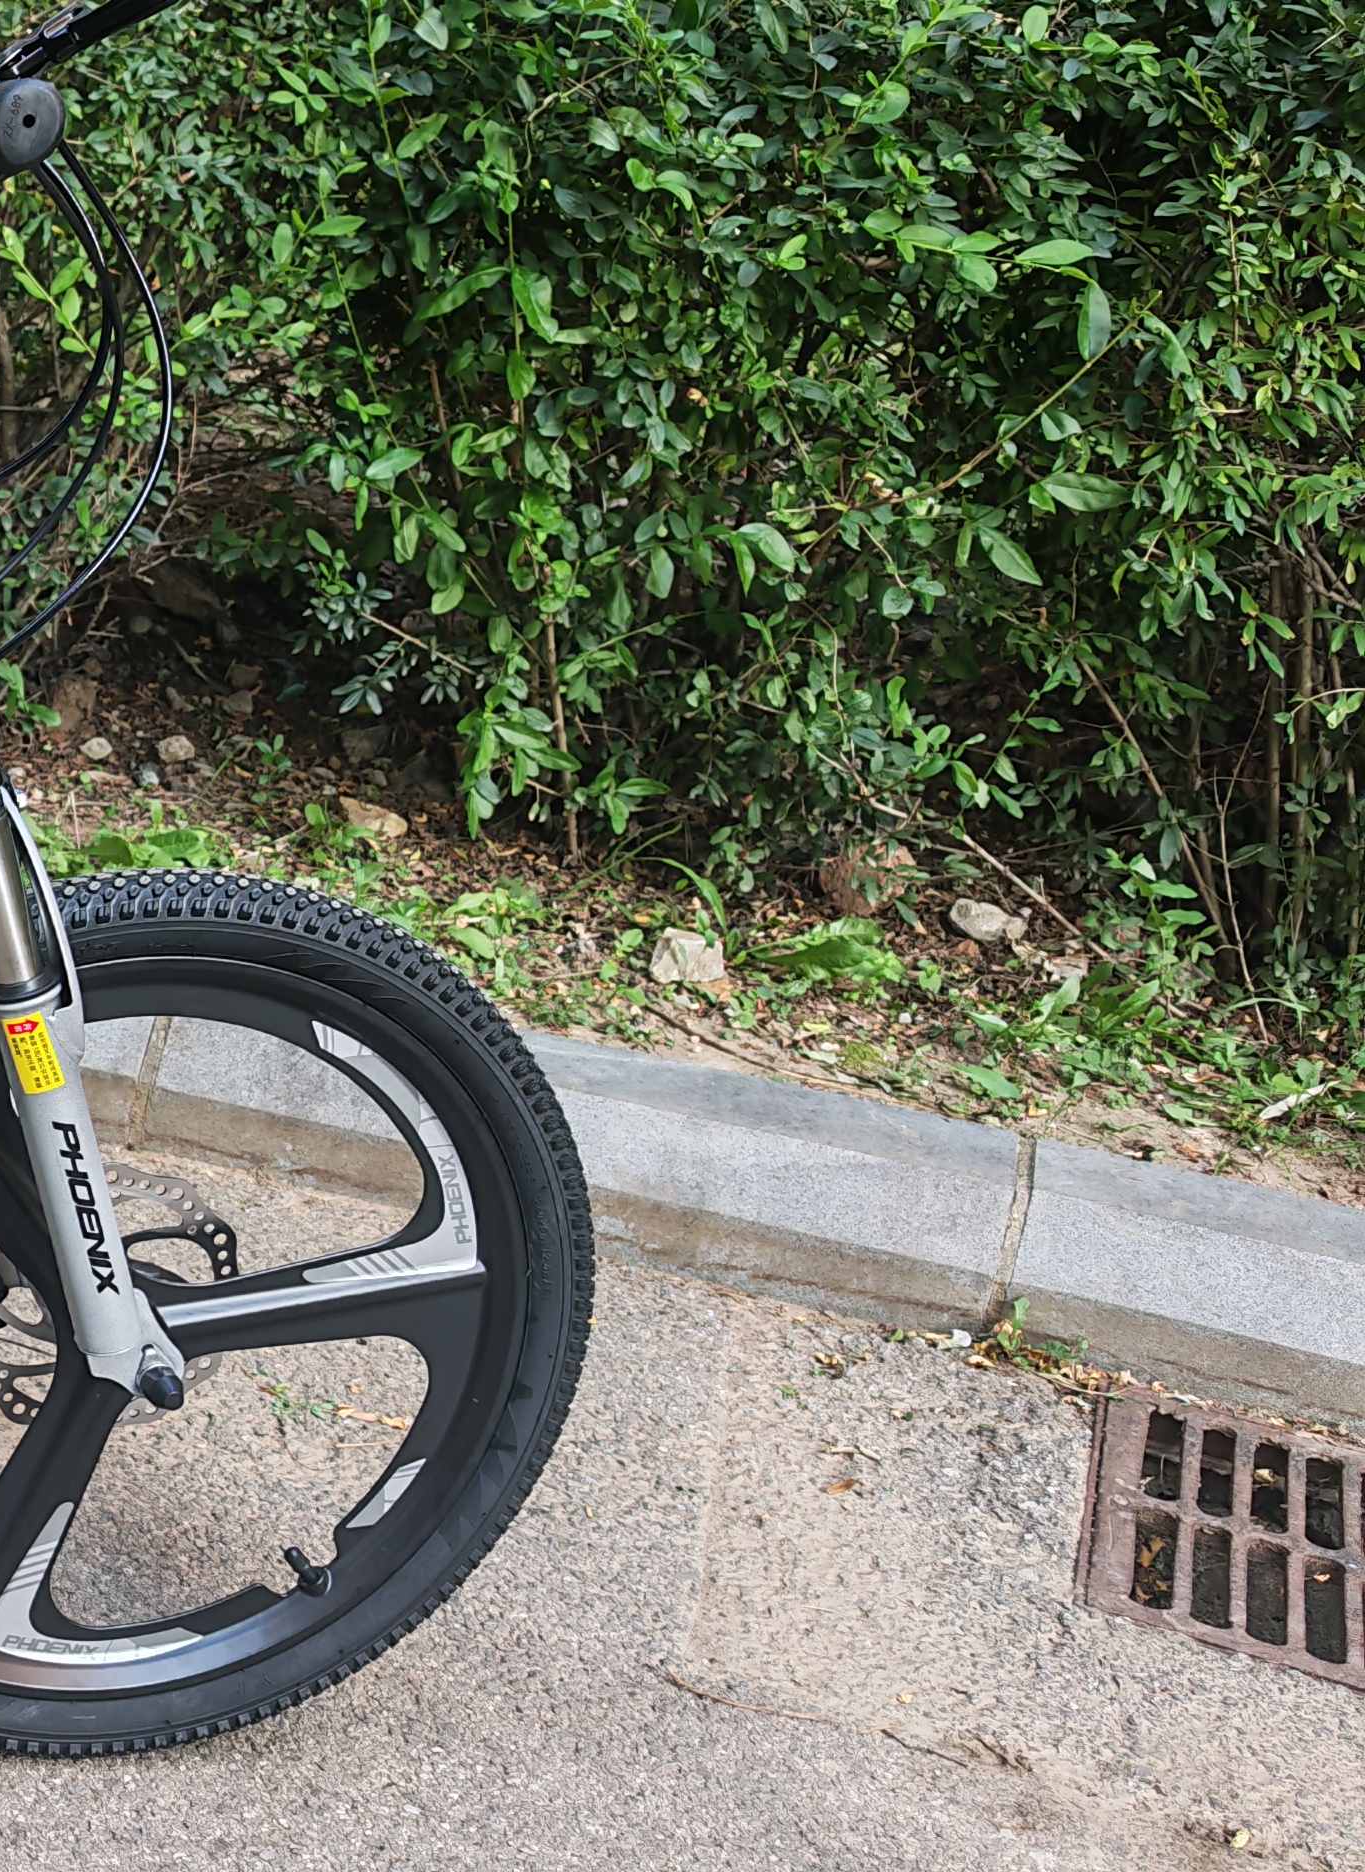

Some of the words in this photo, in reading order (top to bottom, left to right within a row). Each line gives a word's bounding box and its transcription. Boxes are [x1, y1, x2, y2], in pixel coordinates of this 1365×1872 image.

[52, 1121, 120, 1296] PHOENIX
[437, 1153, 473, 1246] PHOENIX
[2, 1633, 100, 1658] PHOENIX
